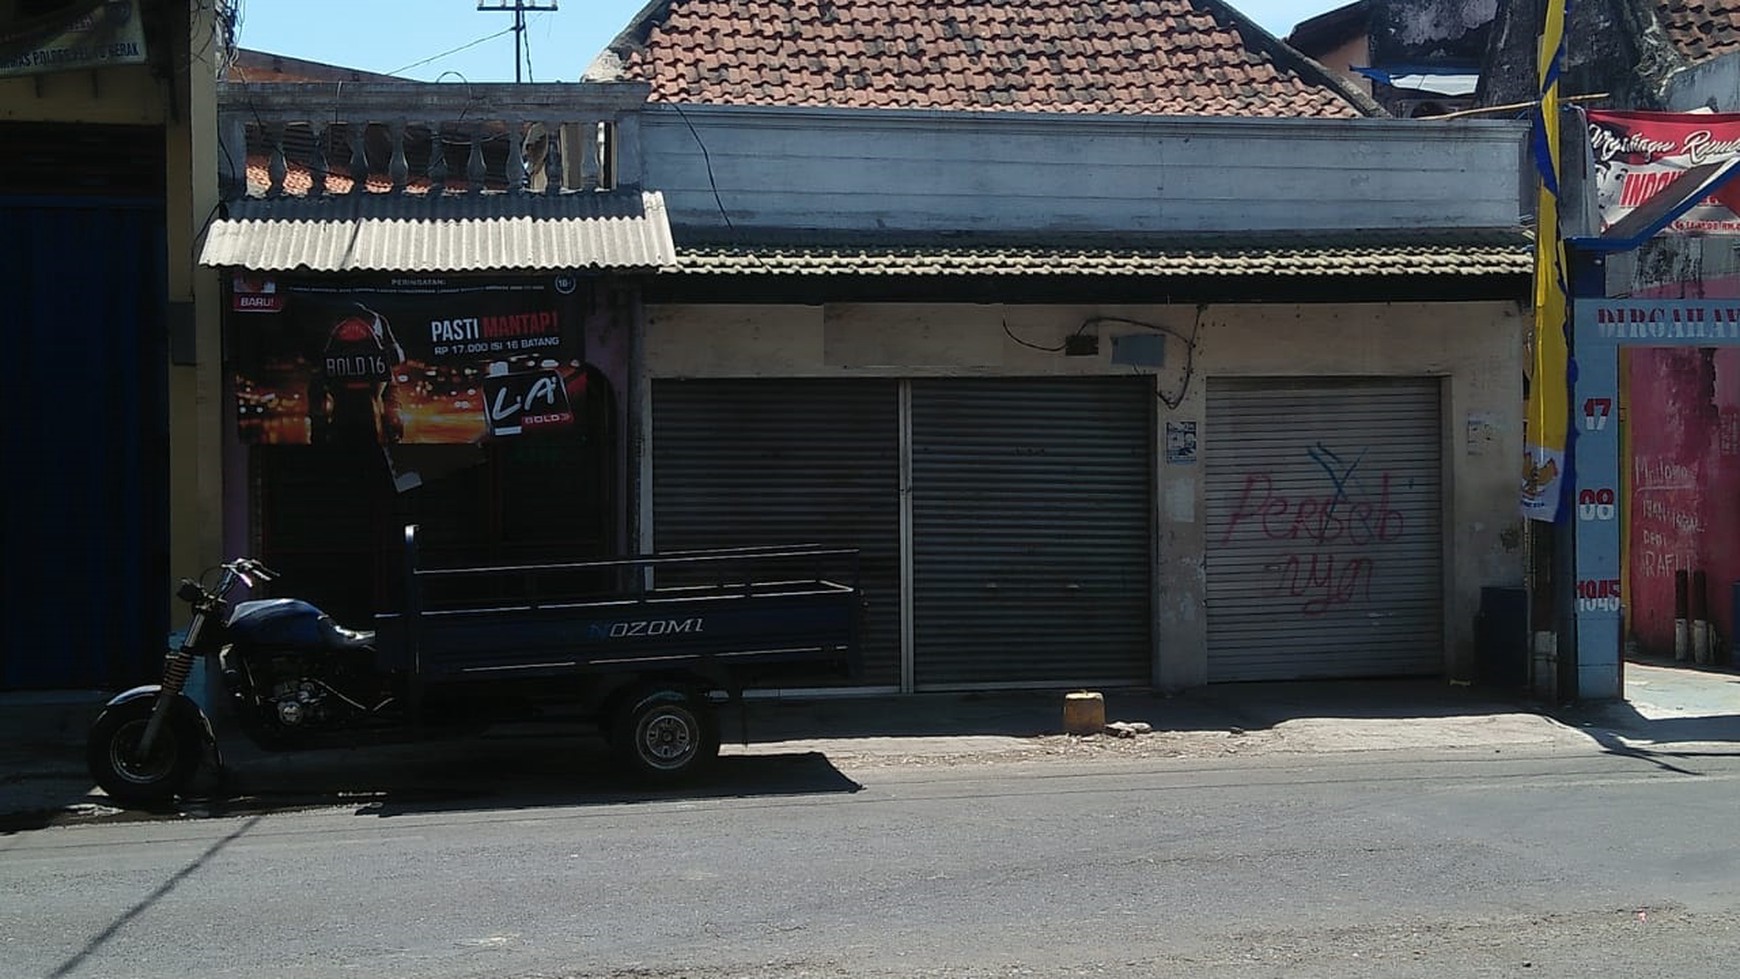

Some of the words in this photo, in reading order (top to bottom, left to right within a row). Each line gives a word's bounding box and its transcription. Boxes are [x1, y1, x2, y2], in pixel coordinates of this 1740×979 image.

[239, 297, 275, 307] BARU!
[431, 318, 480, 342] PASTI
[482, 312, 560, 338] MANTAP!
[434, 346, 449, 356] RP
[452, 343, 489, 354] 17.000
[491, 341, 503, 351] ISI
[506, 340, 519, 350] 16
[521, 337, 560, 349] BATANG
[326, 356, 366, 377] BOLD
[368, 356, 386, 375] 16
[525, 413, 560, 425] BOLD
[1584, 398, 1612, 430] 17
[1579, 488, 1614, 520] 08
